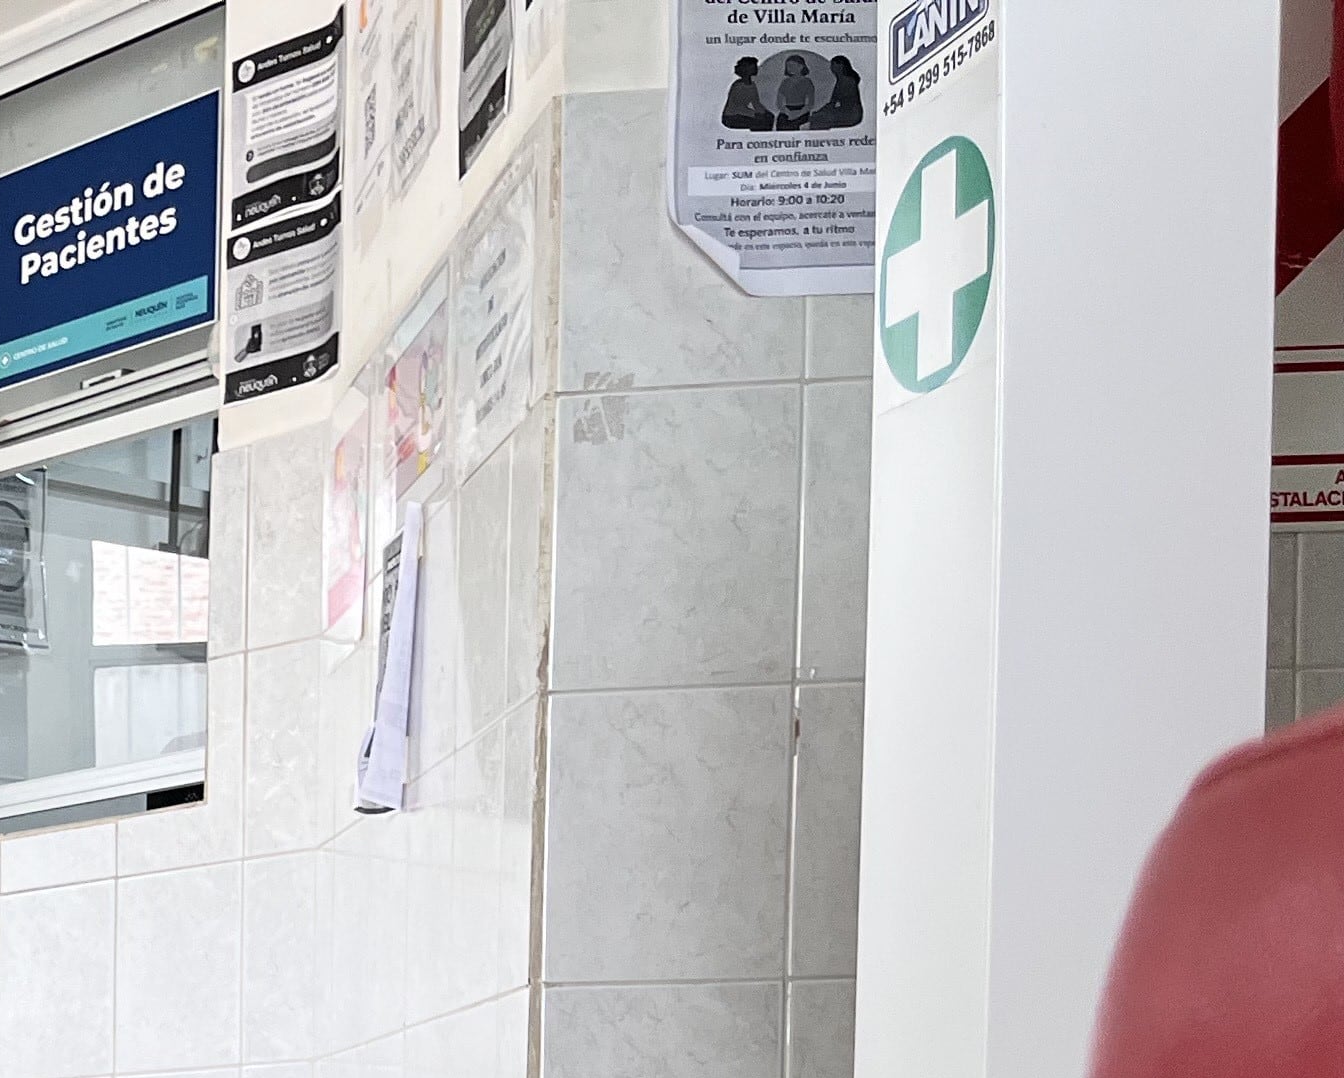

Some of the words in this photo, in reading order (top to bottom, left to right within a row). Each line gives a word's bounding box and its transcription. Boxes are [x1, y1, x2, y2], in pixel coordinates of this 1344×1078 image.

[728, 9, 748, 24] de
[754, 9, 795, 24] Villa
[801, 9, 856, 24] María
[706, 35, 722, 44] un
[725, 33, 757, 46] lugar
[760, 33, 796, 44] donde
[800, 34, 810, 43] te
[814, 33, 877, 43] escuchamo
[883, 88, 905, 116] +54
[908, 82, 915, 102] 9
[918, 63, 940, 95] 299
[943, 20, 995, 76] 515-7868
[716, 139, 743, 150] Para
[746, 137, 800, 149] construir
[804, 137, 845, 148] nuevas
[849, 135, 876, 147] rede
[754, 154, 768, 163] en
[772, 151, 829, 163] confianza
[811, 181, 822, 189] de
[824, 181, 847, 189] Junio
[14, 181, 134, 246] Gestión
[142, 161, 186, 198] de
[730, 196, 775, 207] Horario:
[778, 195, 804, 206] 9:00
[816, 194, 845, 204] 10:20
[735, 214, 751, 222] con
[724, 227, 736, 237] Te
[803, 227, 810, 235] a
[812, 225, 823, 234] tu
[826, 225, 855, 233] ritmo
[21, 207, 177, 285] Pacientes
[1335, 469, 1344, 484] A
